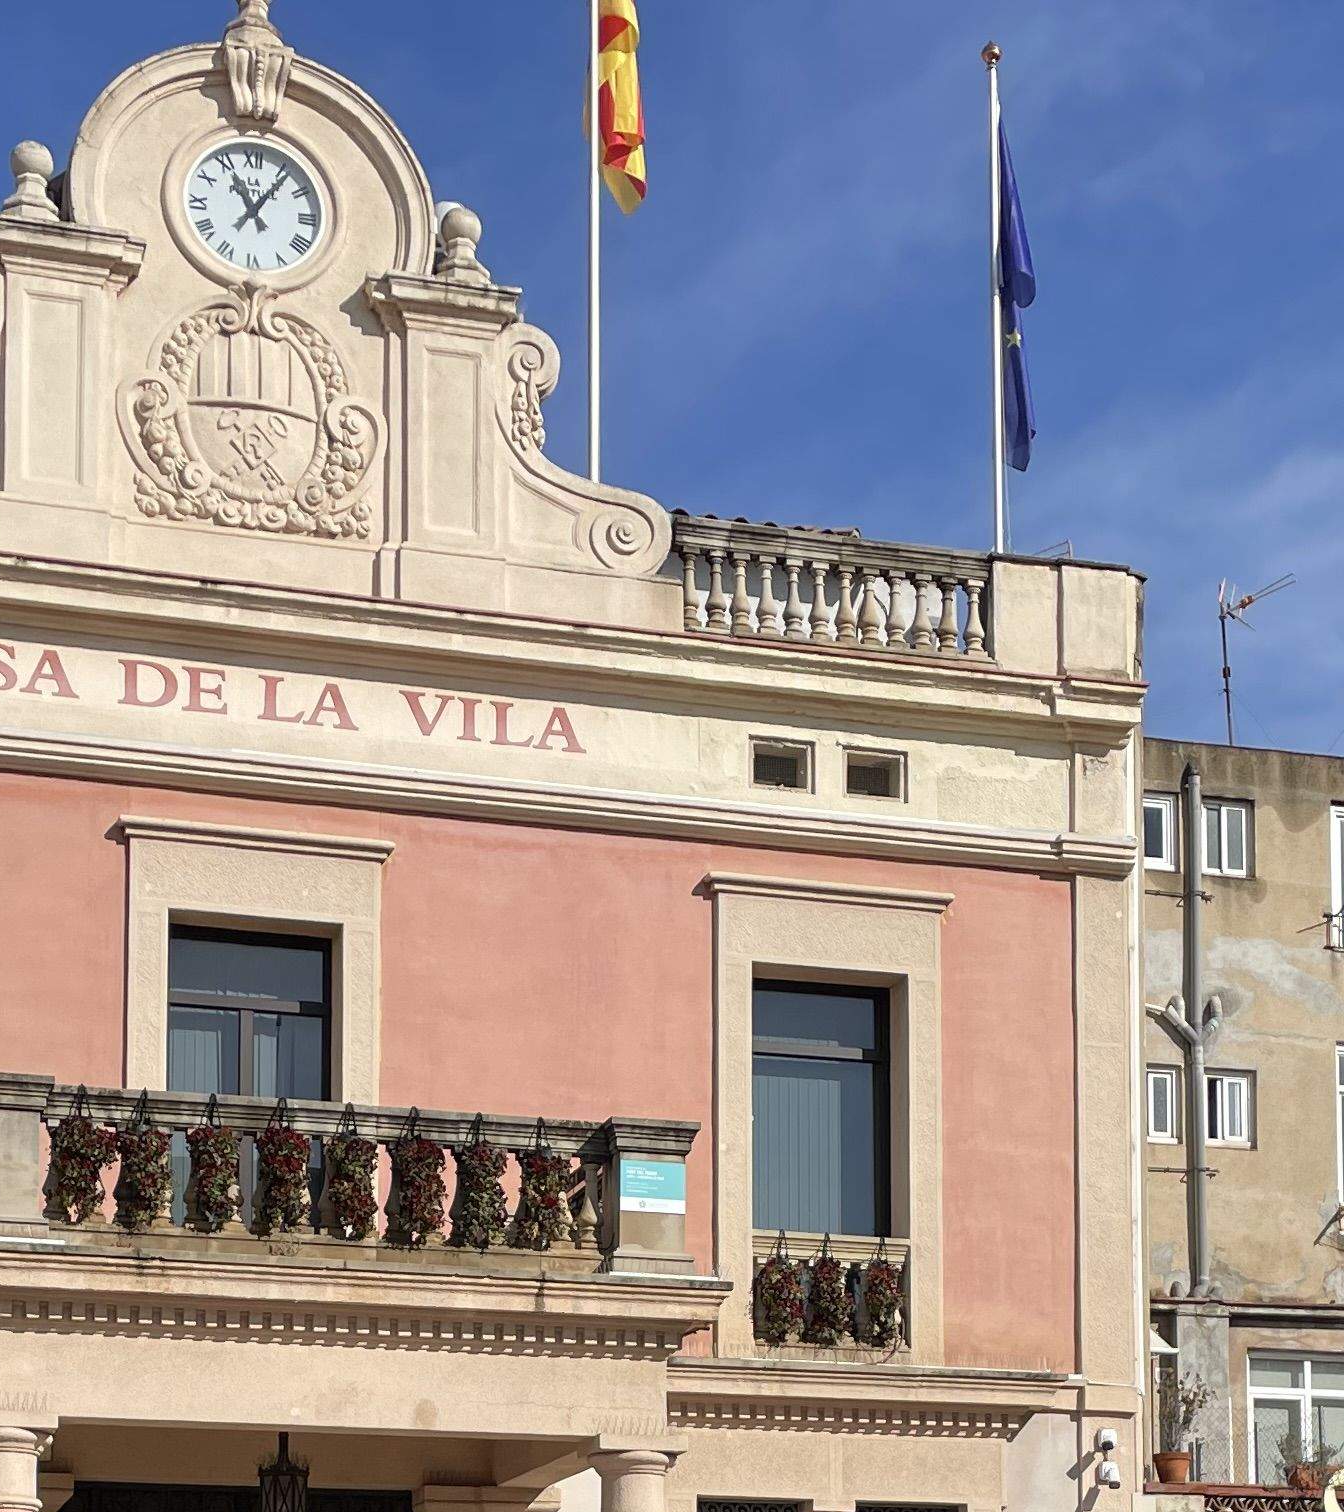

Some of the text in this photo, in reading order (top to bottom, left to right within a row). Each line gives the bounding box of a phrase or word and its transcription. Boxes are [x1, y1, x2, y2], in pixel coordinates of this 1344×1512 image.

[215, 152, 235, 173] XI
[244, 150, 263, 169] XII
[197, 169, 217, 187] X
[188, 194, 208, 210] IX
[298, 213, 316, 226] III
[117, 658, 228, 715] DE
[257, 674, 359, 731] LA
[399, 689, 587, 753] VILA
